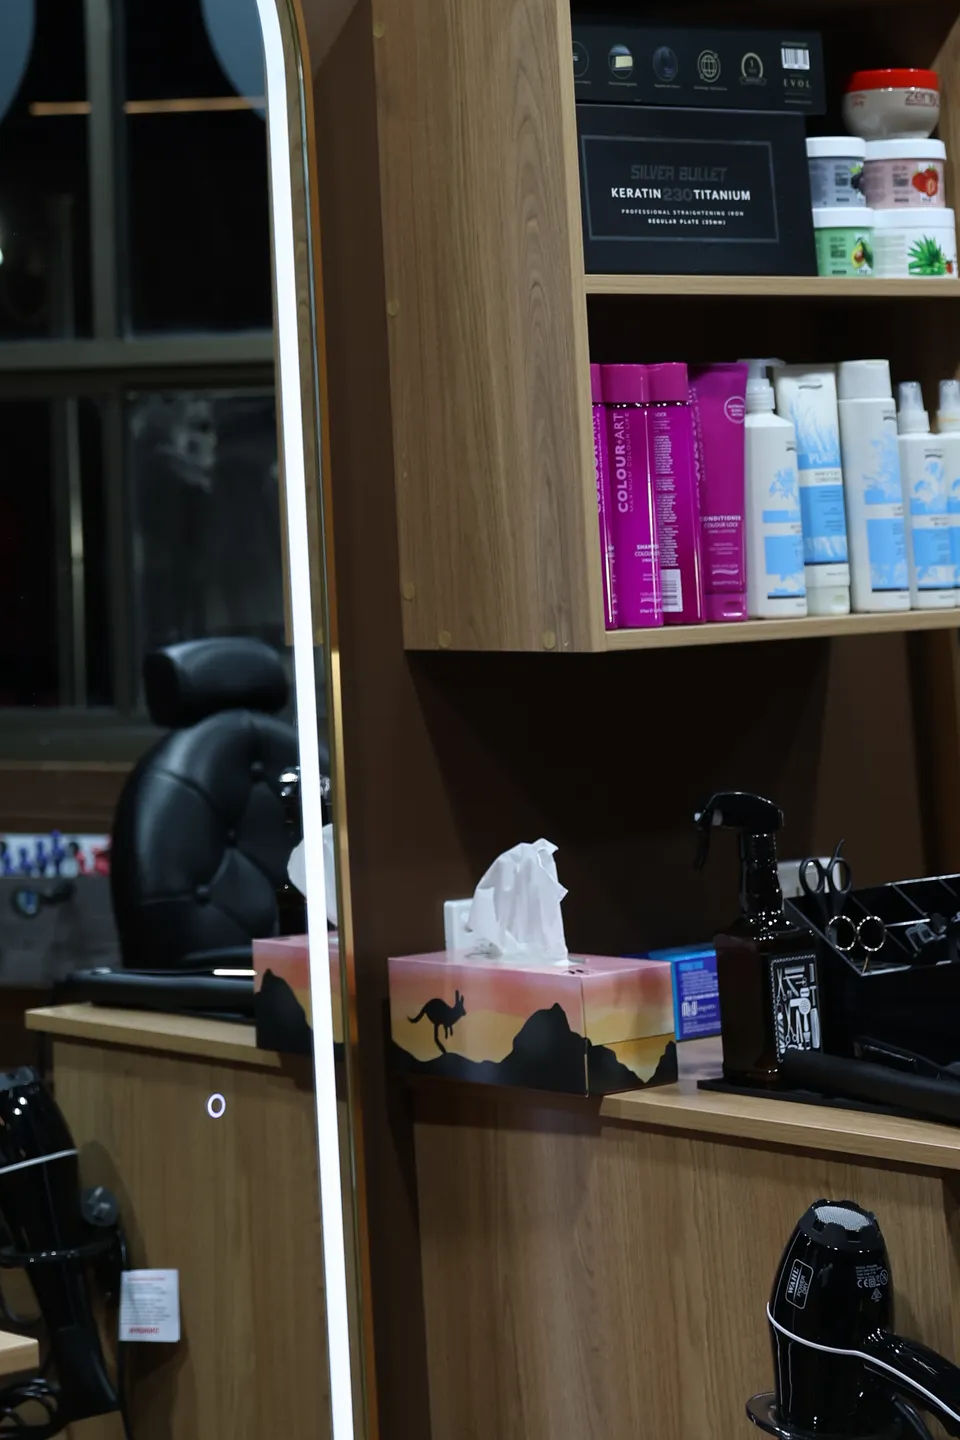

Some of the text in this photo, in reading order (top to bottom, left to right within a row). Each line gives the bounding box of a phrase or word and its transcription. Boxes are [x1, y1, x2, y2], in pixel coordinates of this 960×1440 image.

[630, 164, 728, 182] SILVER BULLET
[611, 187, 661, 199] KERATIN
[693, 189, 751, 201] TITANIUM
[621, 208, 671, 216] PROFESSIONAL
[787, 1266, 800, 1294] WAHL
